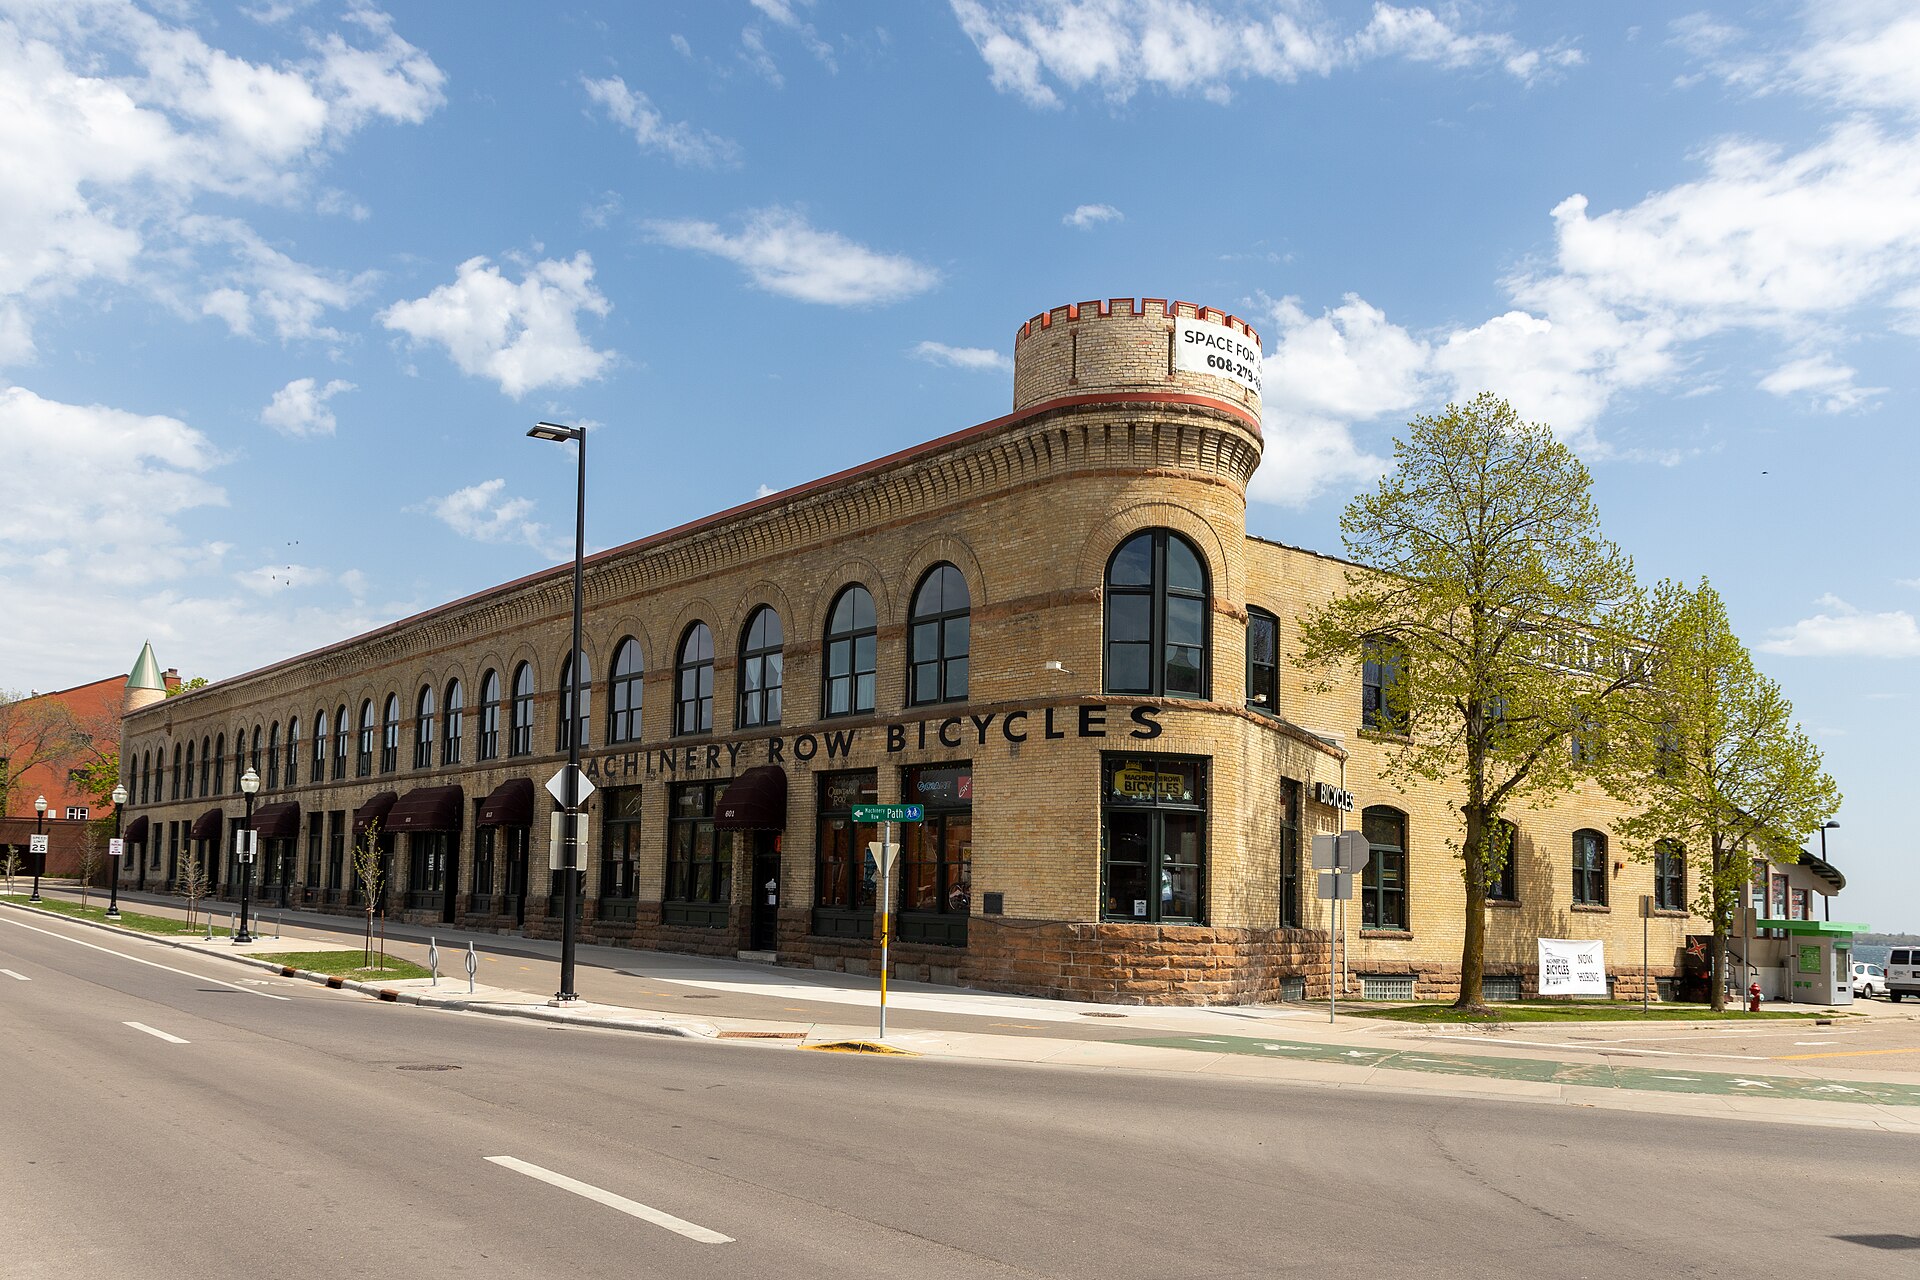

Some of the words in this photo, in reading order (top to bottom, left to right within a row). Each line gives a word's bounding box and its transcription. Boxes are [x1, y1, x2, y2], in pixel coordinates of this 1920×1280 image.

[1184, 330, 1233, 353] SPACE
[1236, 343, 1255, 365] FOR
[1207, 355, 1262, 391] 608-279-
[579, 742, 742, 778] ACHINERY
[768, 730, 855, 763] ROW
[887, 705, 1163, 753] BICYCLES
[1124, 781, 1180, 794] BICYCLES
[1321, 783, 1354, 812] BICYCLES
[887, 808, 904, 819] Path
[1577, 954, 1593, 964] NOW
[1546, 965, 1569, 975] BICYCLES
